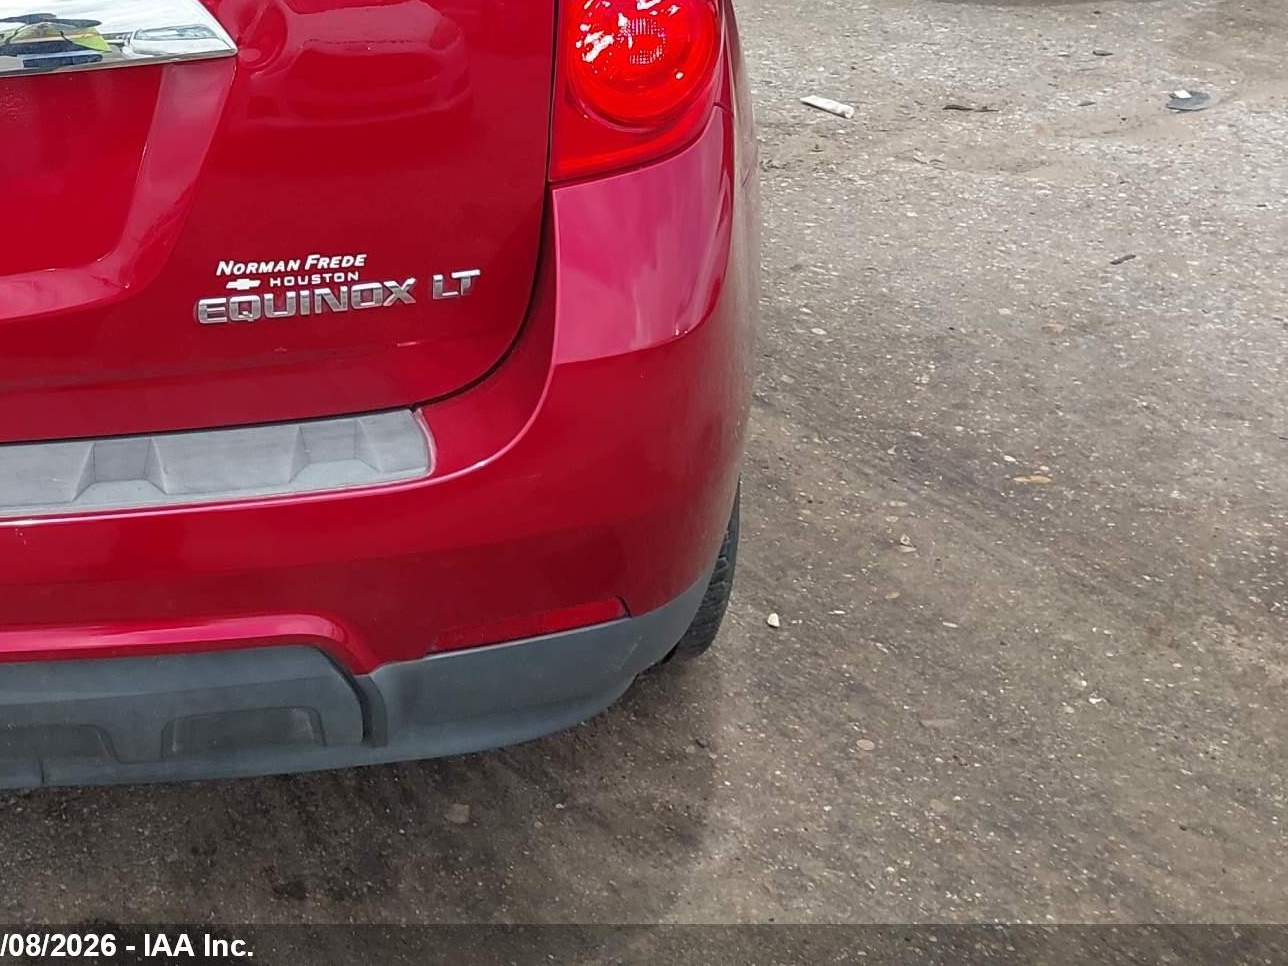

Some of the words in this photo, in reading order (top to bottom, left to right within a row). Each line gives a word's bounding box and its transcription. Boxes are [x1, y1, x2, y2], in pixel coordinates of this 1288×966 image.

[195, 277, 416, 324] EQUINOX
[431, 268, 481, 299] LT
[269, 270, 359, 287] HOUSTON
